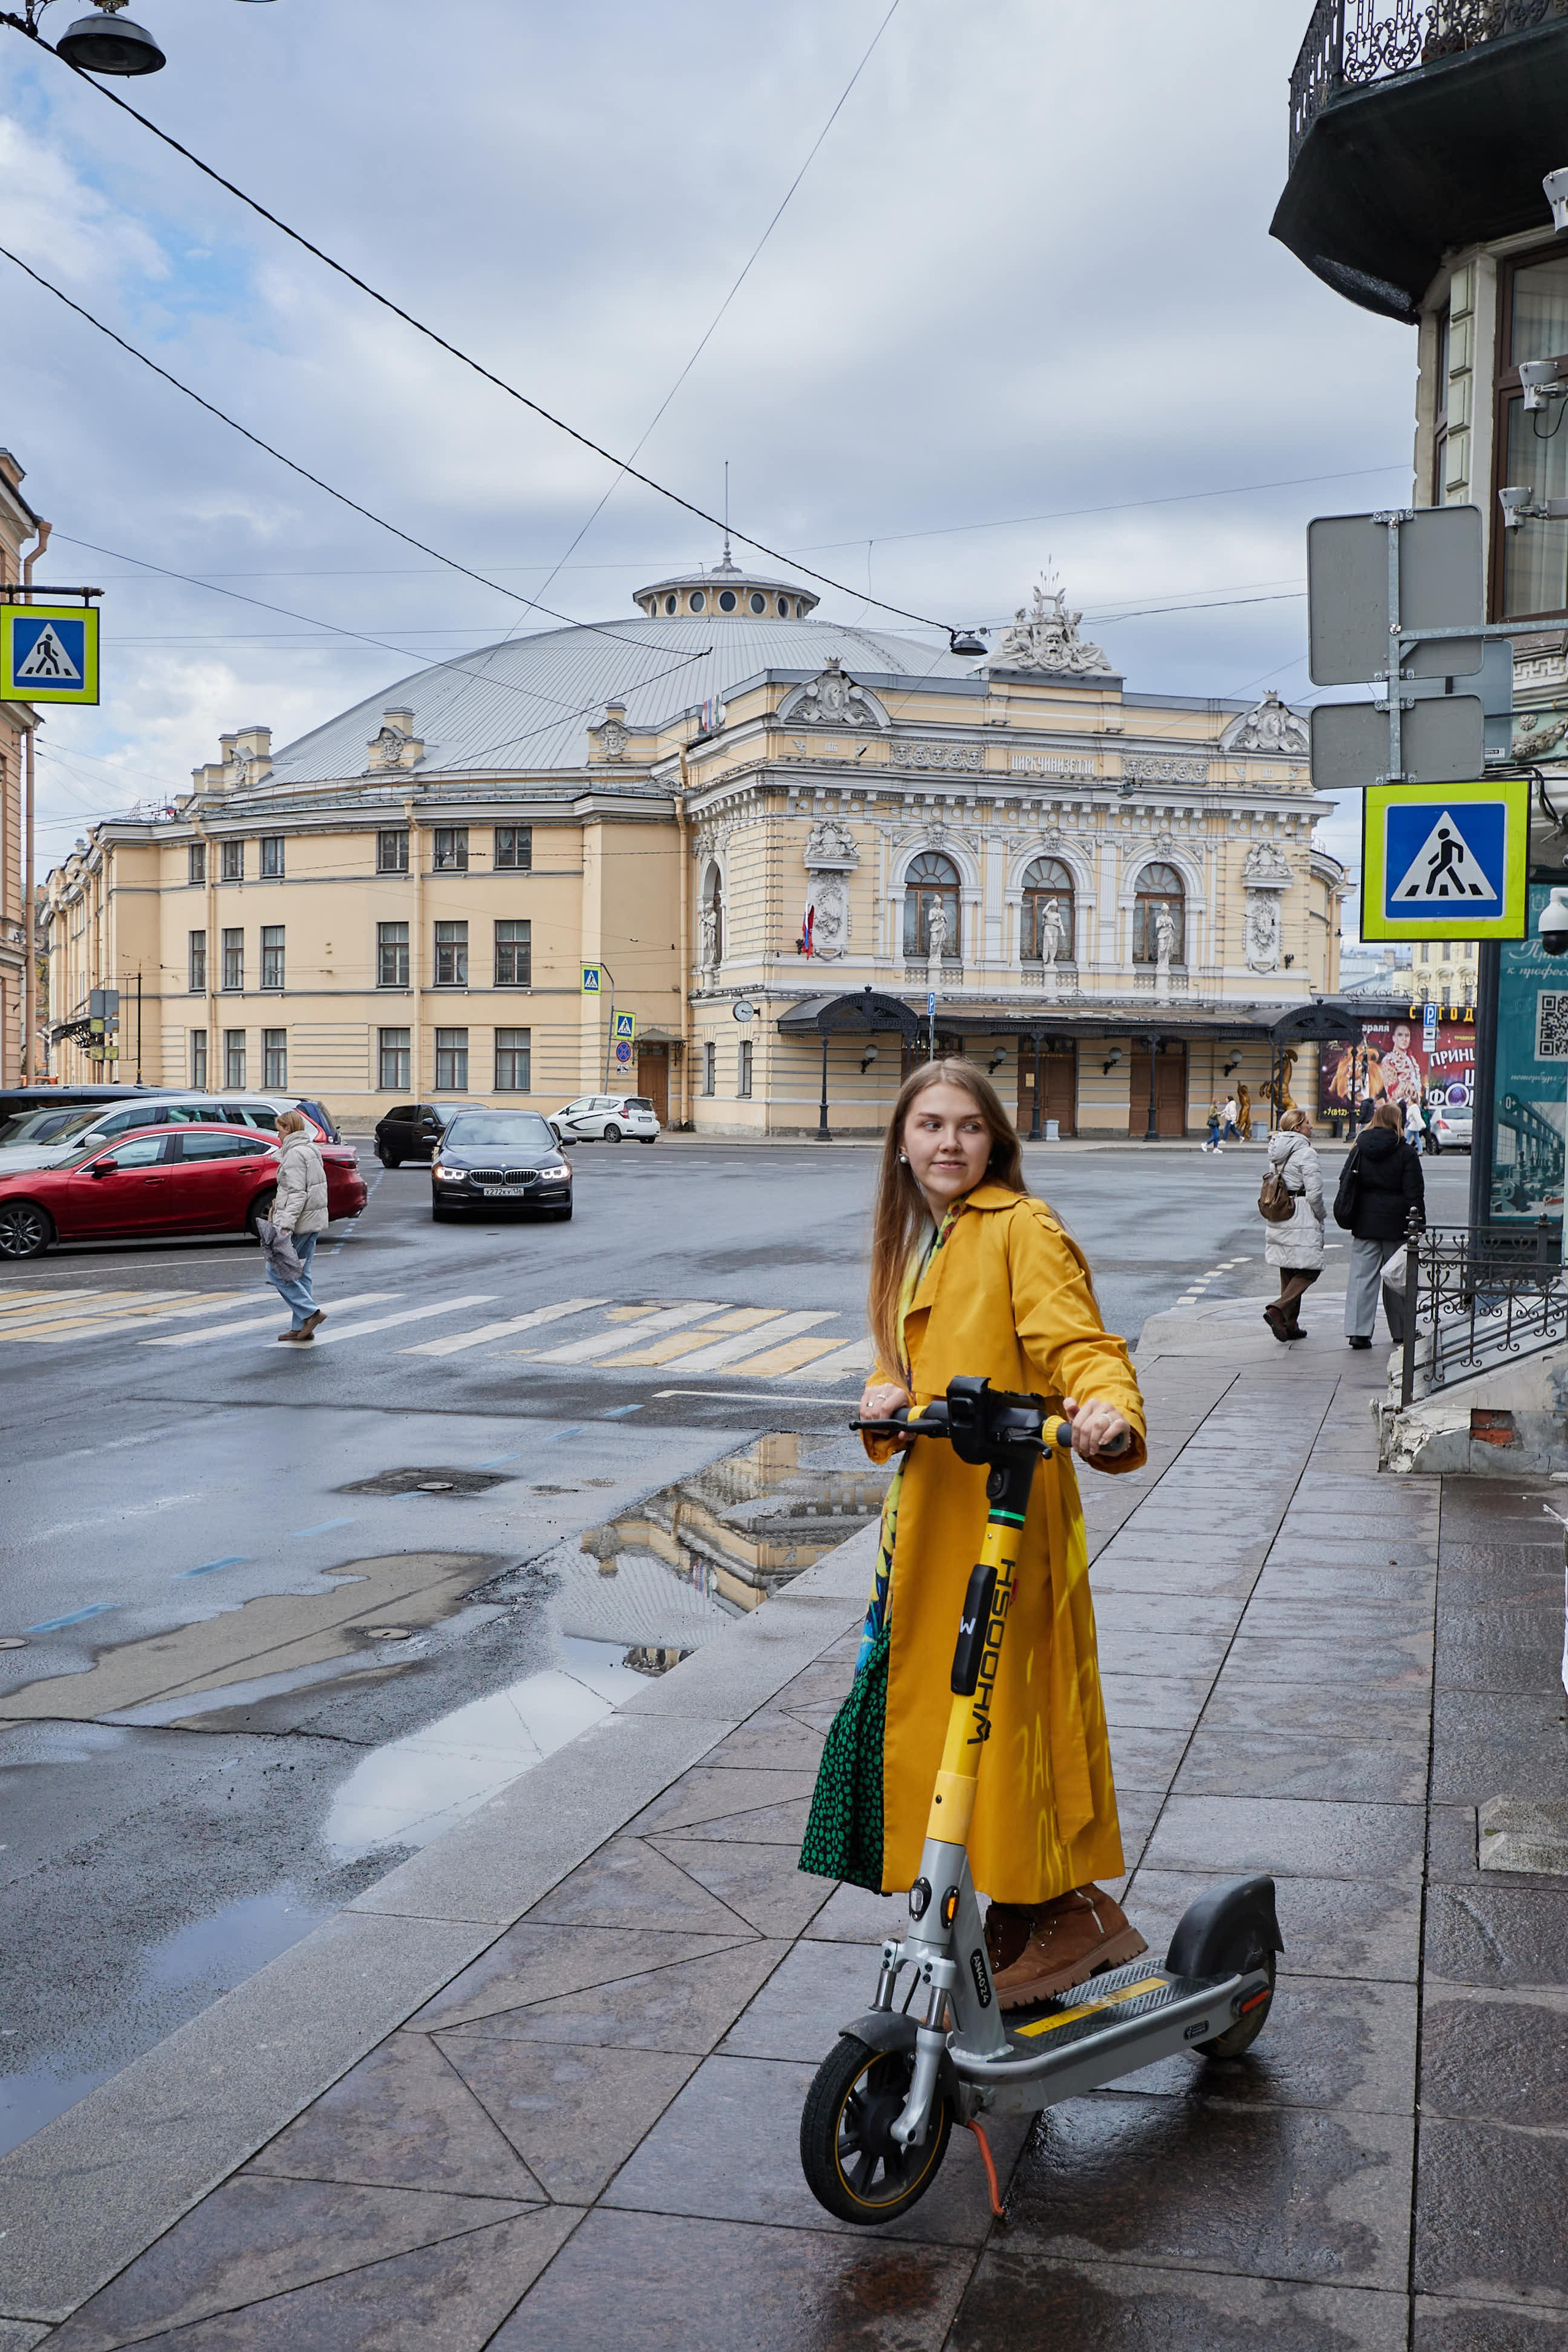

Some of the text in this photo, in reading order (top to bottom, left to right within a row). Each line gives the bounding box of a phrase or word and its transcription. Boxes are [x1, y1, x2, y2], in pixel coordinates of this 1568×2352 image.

[1011, 755, 1095, 774] ЦИРК ЧИНИЗЕЛЛИ
[1520, 963, 1568, 979] профес
[967, 1558, 1016, 1744] WHOOSH
[973, 1956, 989, 2003] AN4024
